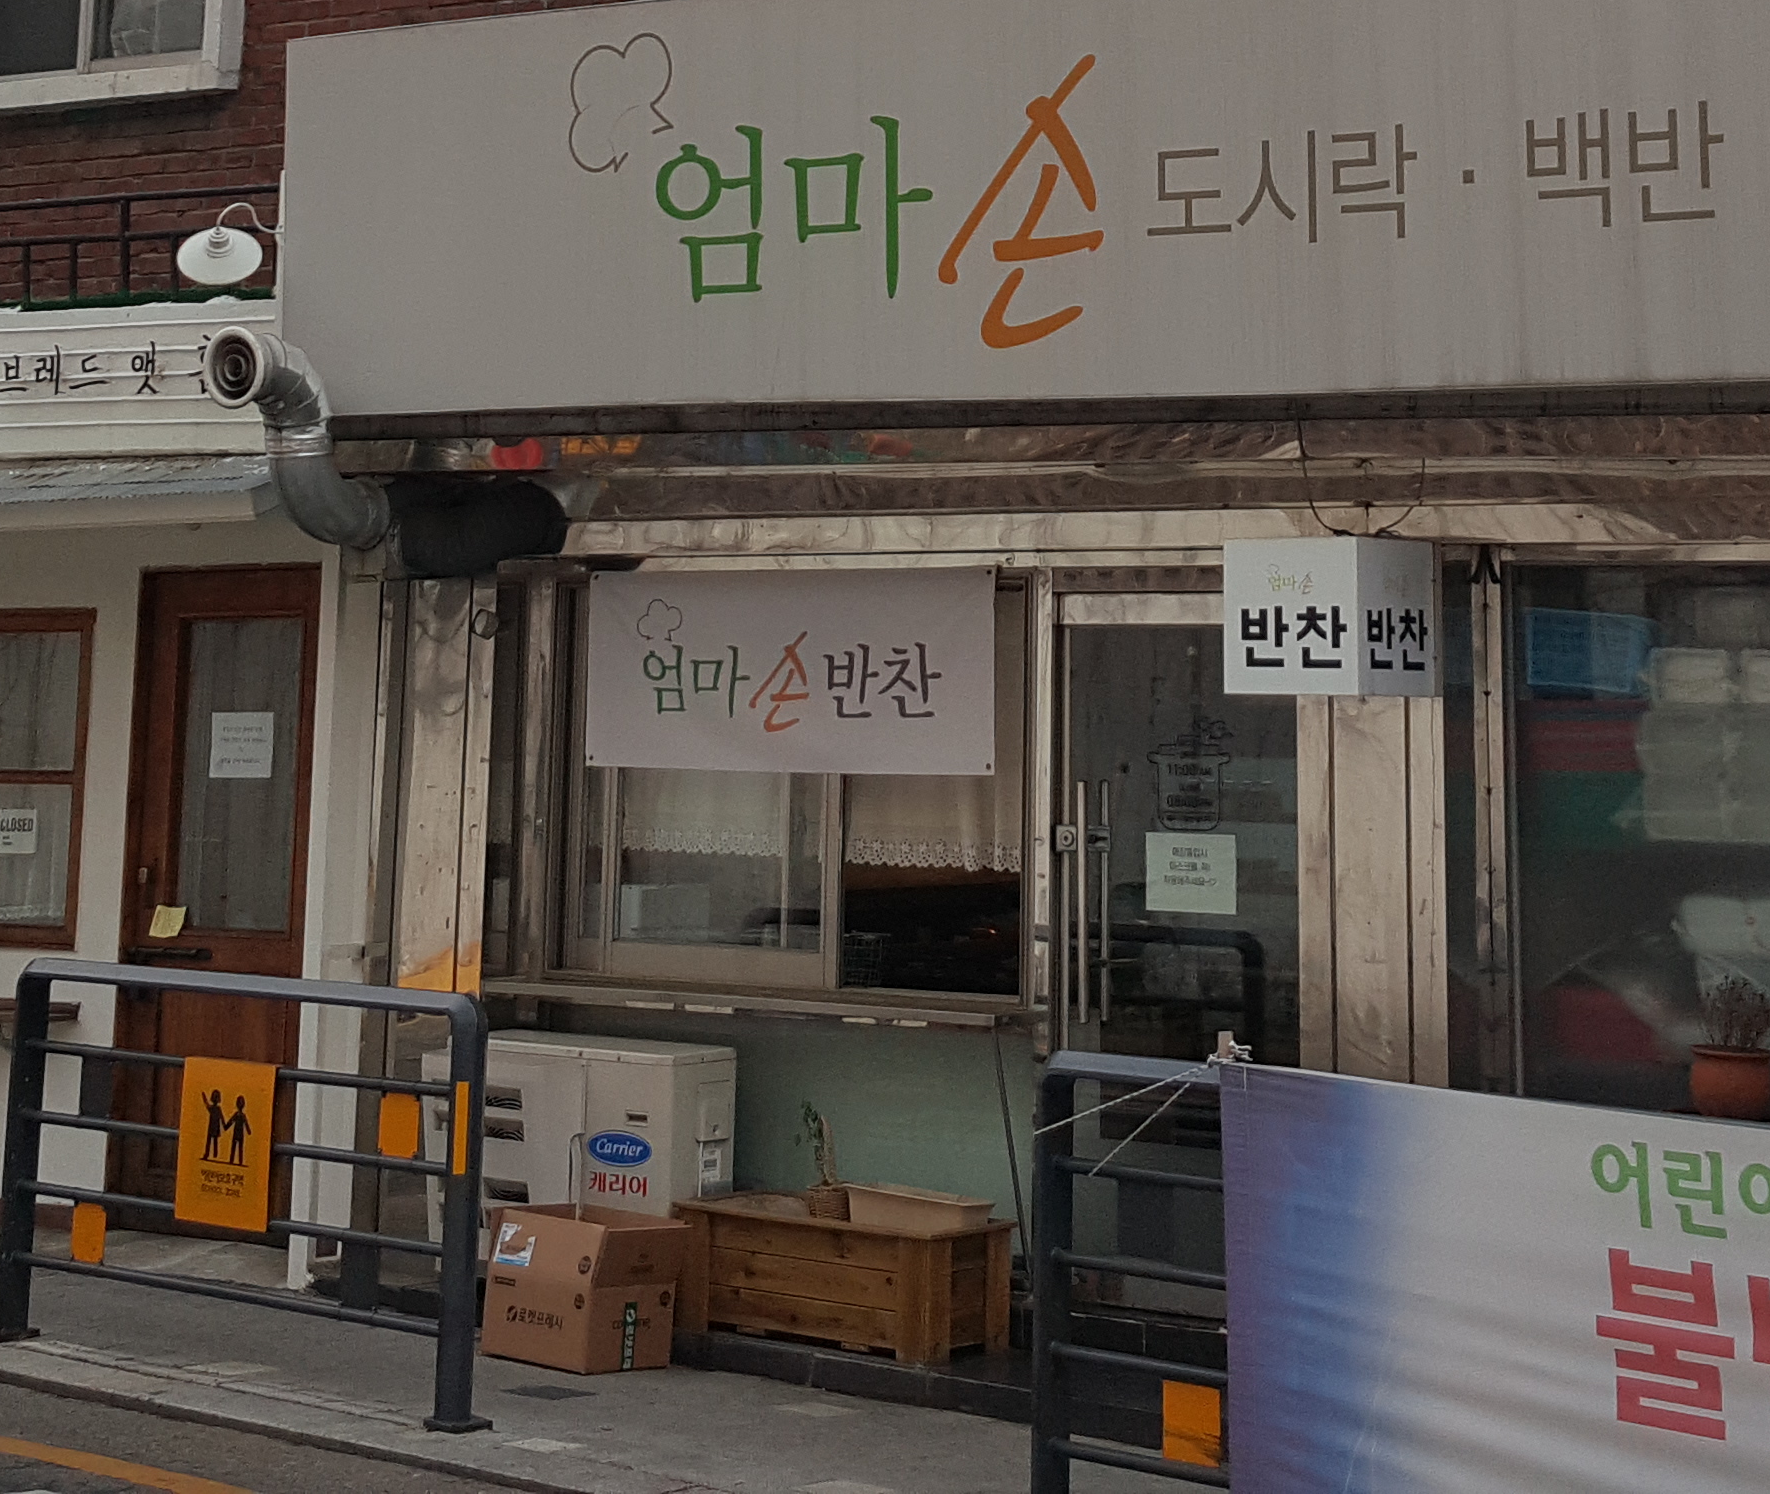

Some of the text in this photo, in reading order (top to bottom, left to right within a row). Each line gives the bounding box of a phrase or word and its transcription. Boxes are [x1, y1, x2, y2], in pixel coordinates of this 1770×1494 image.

[654, 53, 1105, 350] 엄마손
[1145, 122, 1419, 244] 도시락
[1524, 100, 1725, 229] 백반
[130, 340, 161, 395] 앳
[1240, 605, 1348, 669] 반찬
[1366, 607, 1429, 671] 반찬
[0, 817, 34, 833] CLOSED
[595, 1138, 644, 1158] Carrier
[587, 1170, 649, 1198] 캐리어
[517, 1307, 564, 1331] 로켓프레시
